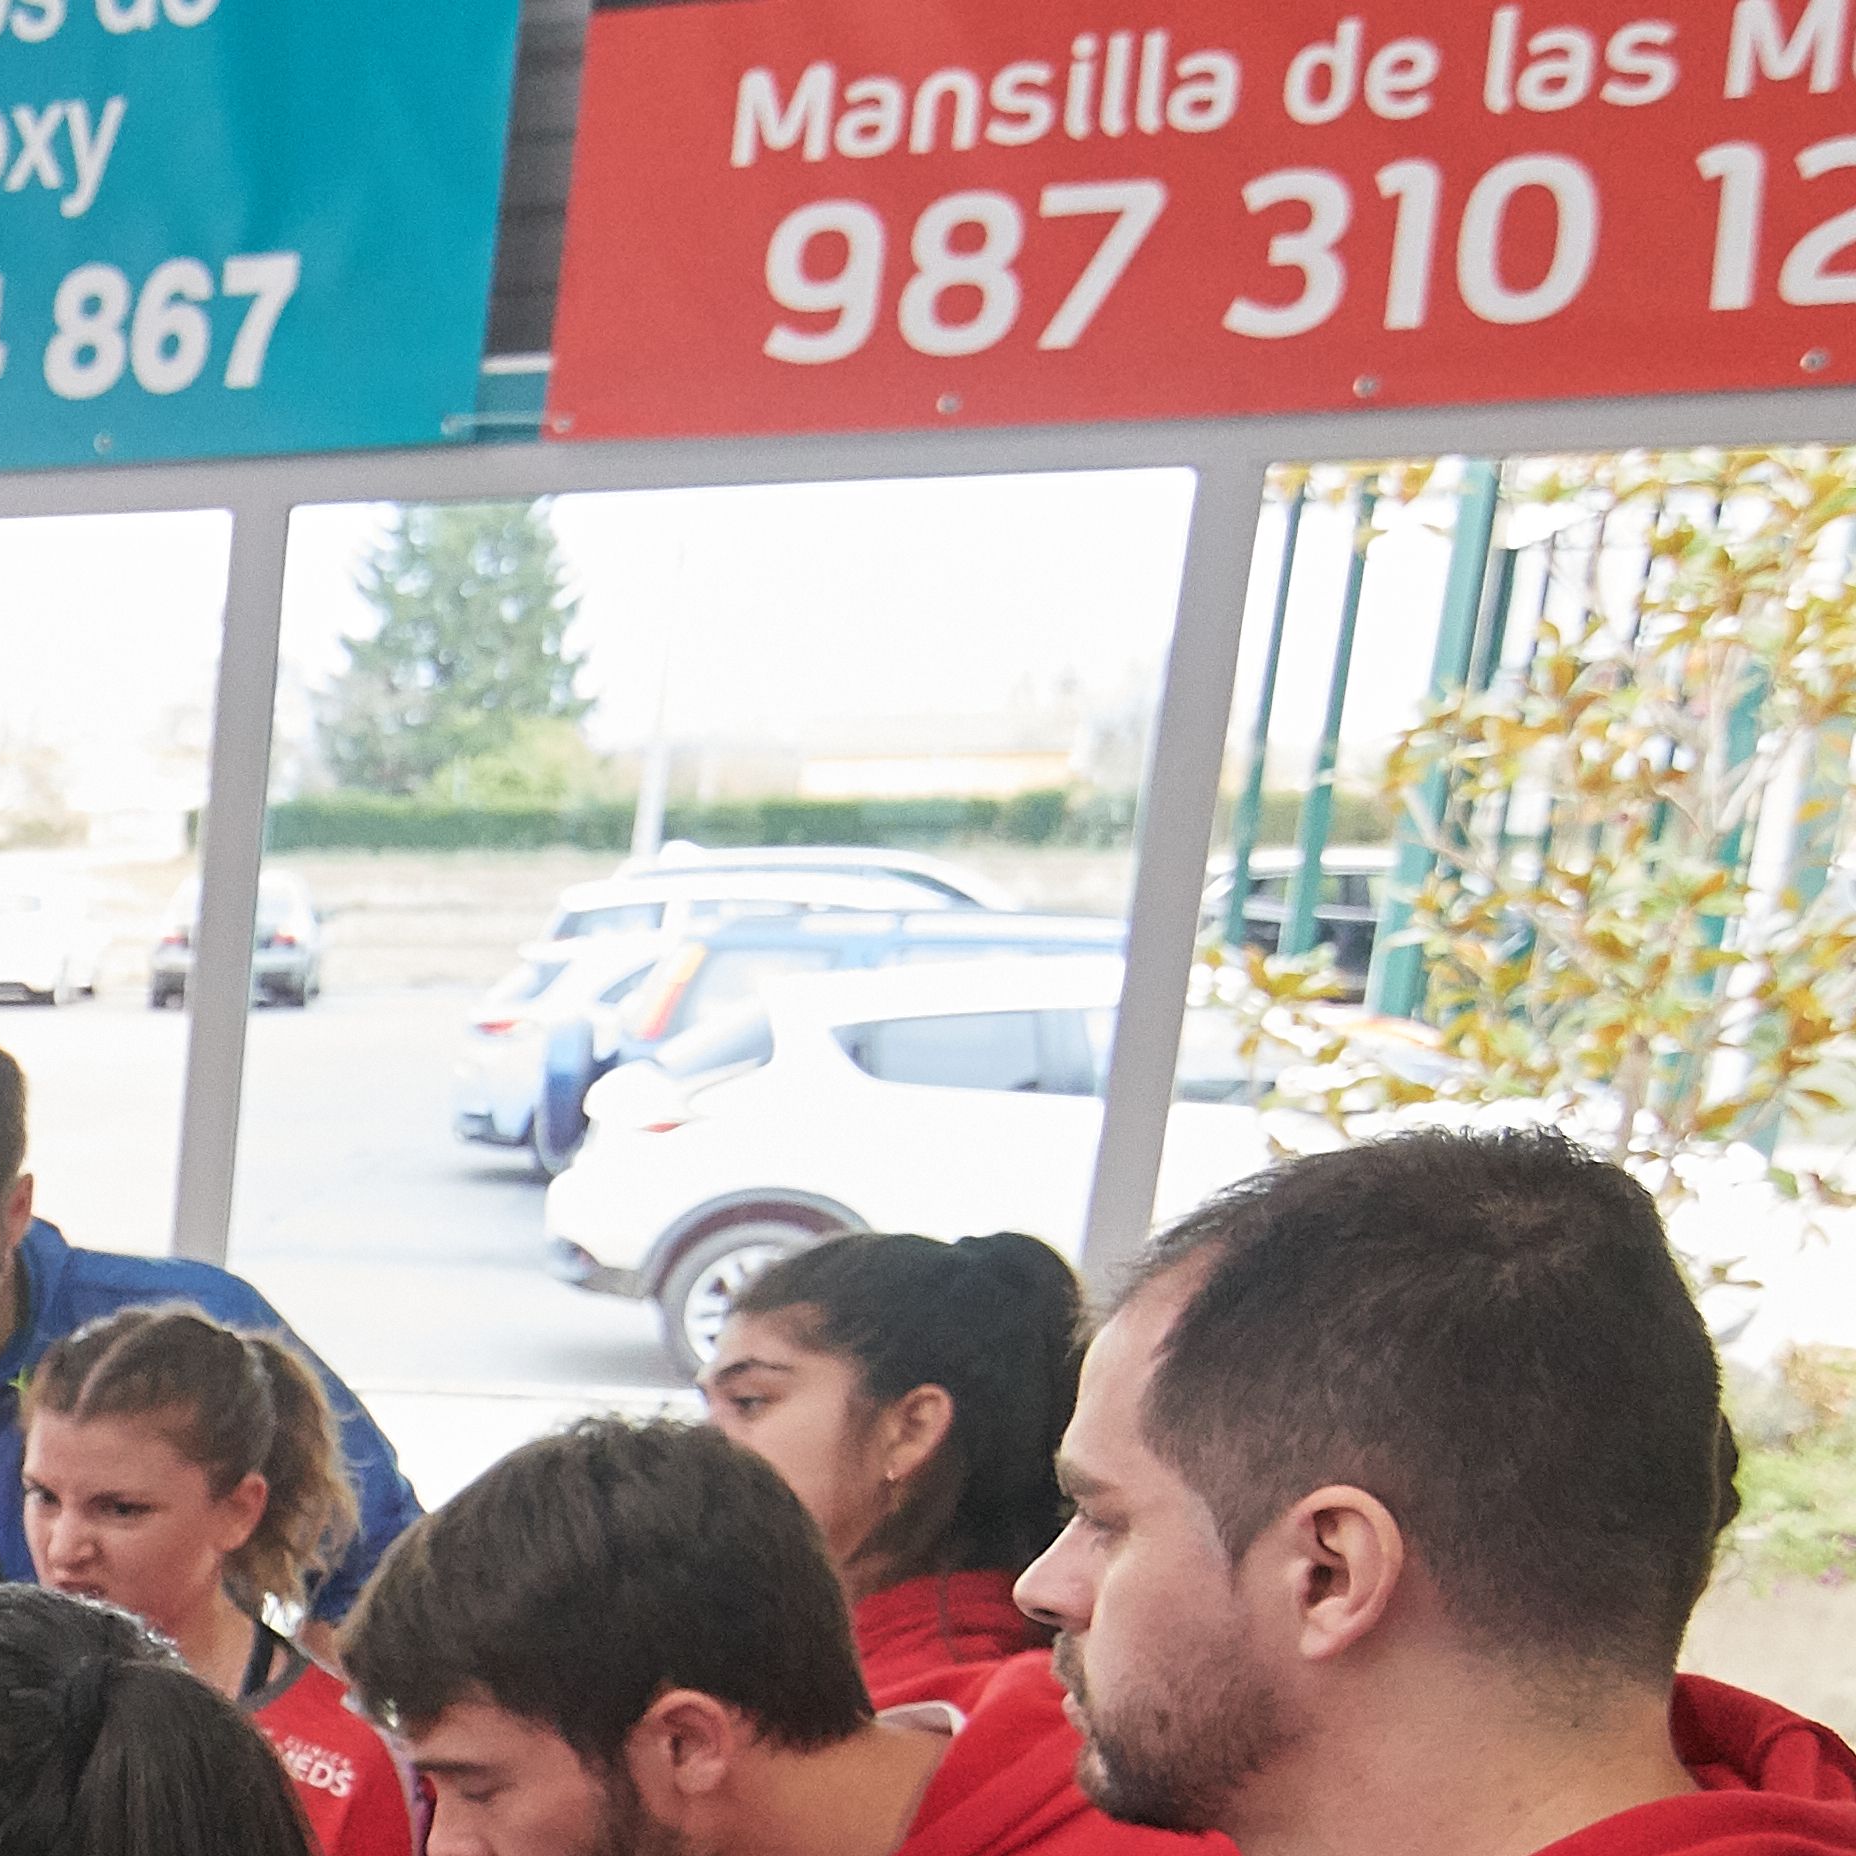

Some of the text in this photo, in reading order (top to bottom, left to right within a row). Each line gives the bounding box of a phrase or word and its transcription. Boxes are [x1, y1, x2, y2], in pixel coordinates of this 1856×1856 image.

[728, 0, 1856, 168] Mansilla de las M
[42, 252, 304, 402] 867
[762, 178, 1170, 365] 987
[1220, 150, 1604, 340] 310
